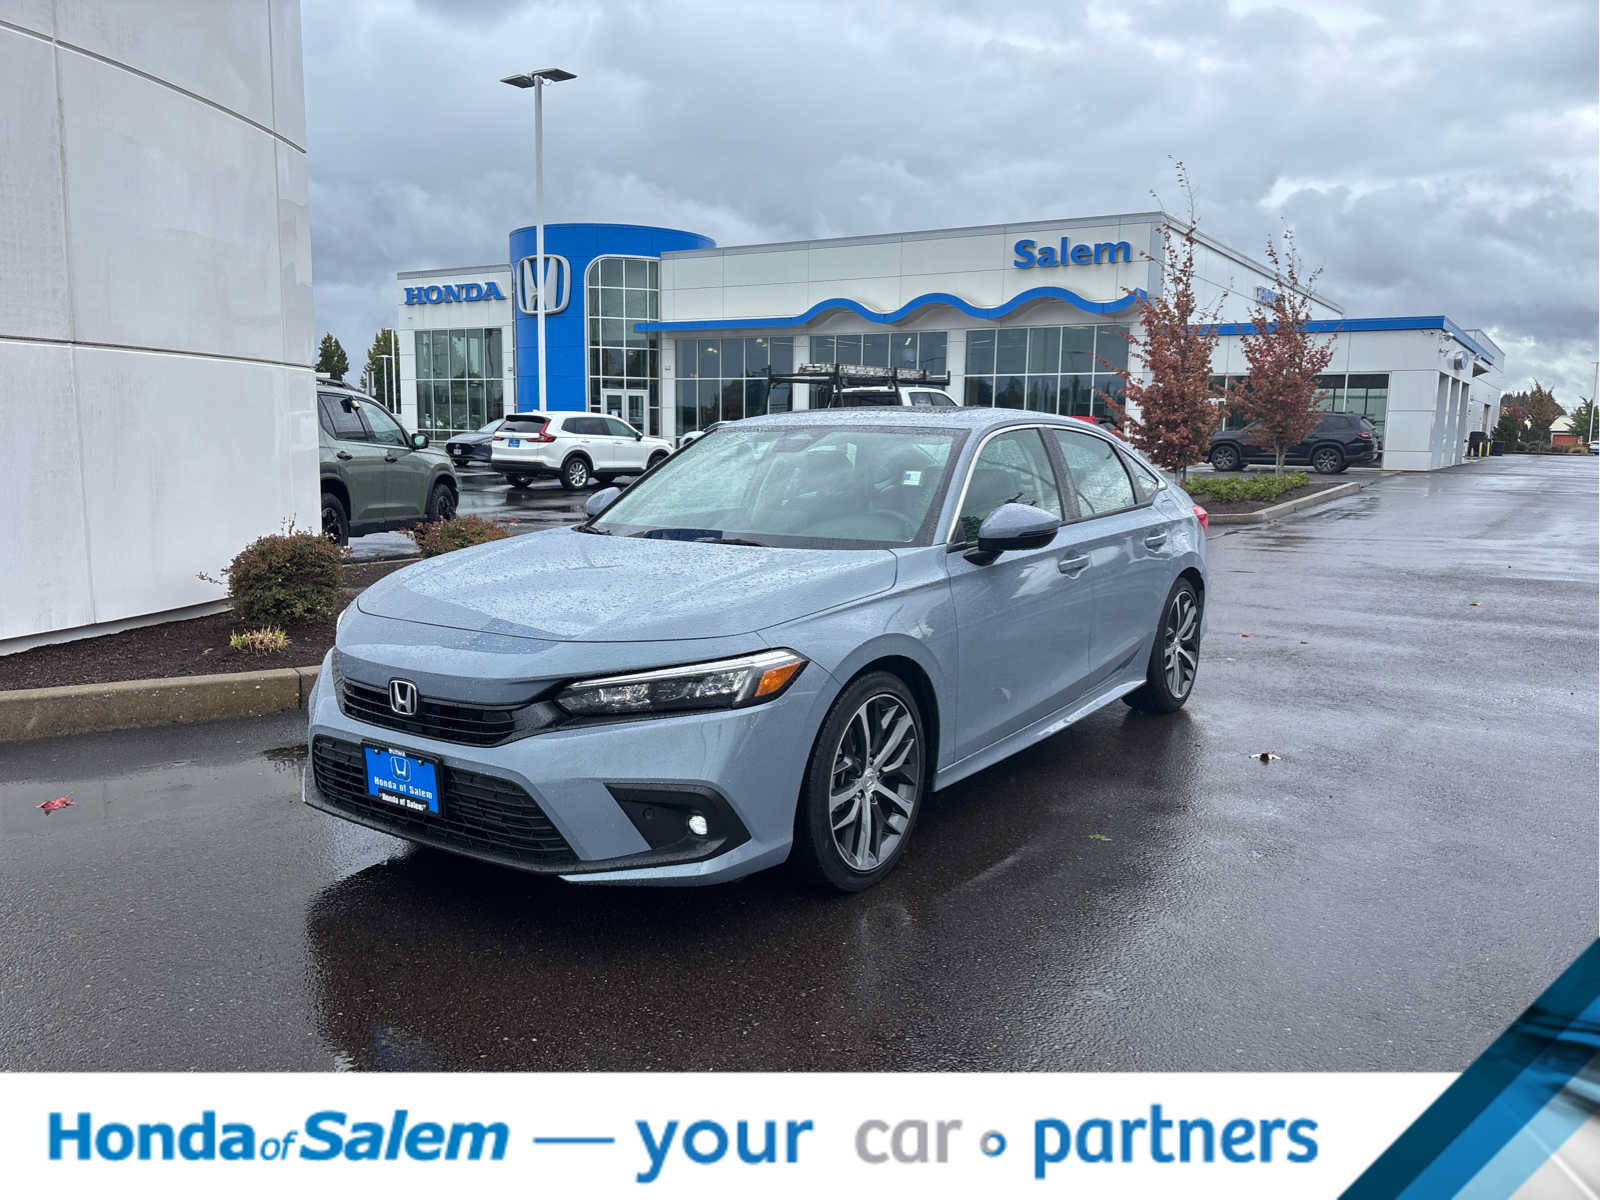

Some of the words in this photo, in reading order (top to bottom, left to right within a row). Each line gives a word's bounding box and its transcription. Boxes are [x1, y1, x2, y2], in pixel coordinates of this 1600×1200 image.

[1013, 236, 1131, 269] Salem
[404, 281, 506, 305] HONDA
[374, 775, 397, 790] Honda
[400, 784, 407, 793] of
[409, 785, 433, 800] Salem
